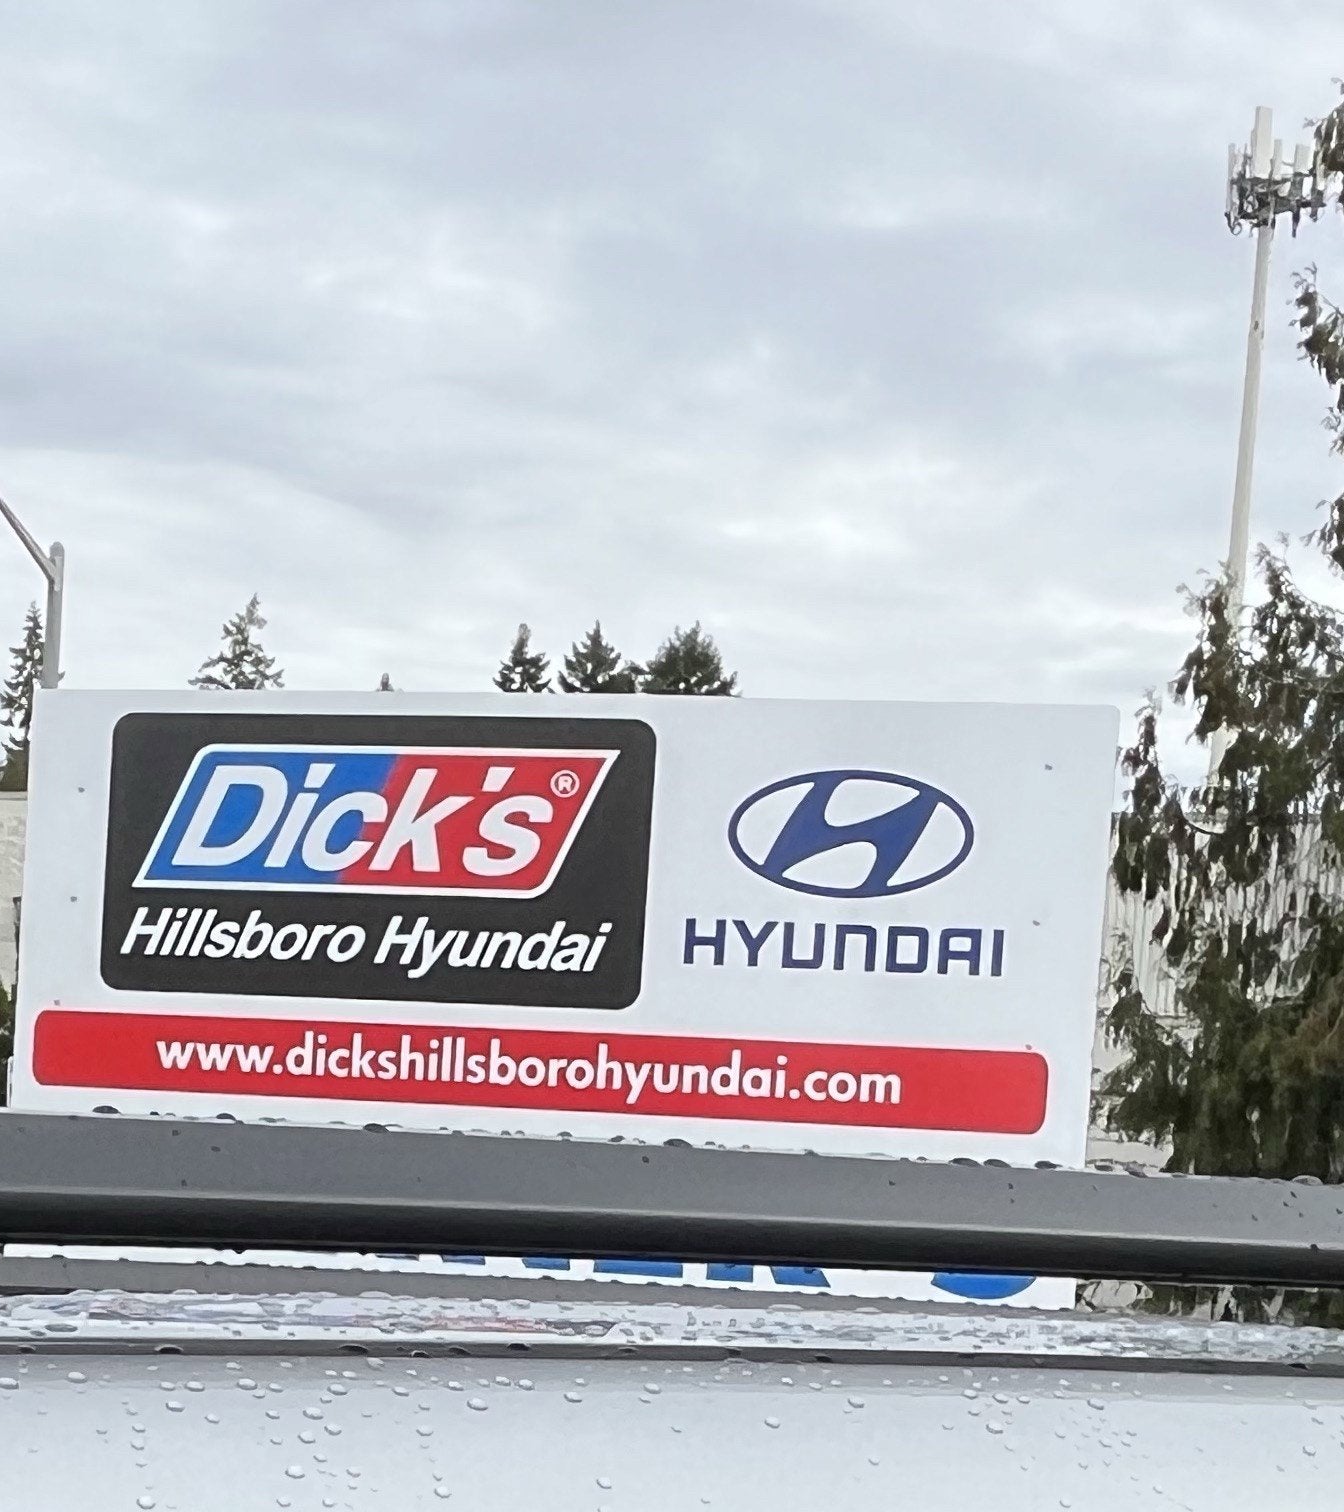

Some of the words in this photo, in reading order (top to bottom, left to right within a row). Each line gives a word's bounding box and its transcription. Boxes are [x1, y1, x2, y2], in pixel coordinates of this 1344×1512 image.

[171, 762, 554, 877] Dick's
[119, 906, 366, 964] Hillsboro
[373, 915, 613, 979] Hyundai
[683, 917, 1004, 978] HYUNDAI
[156, 1030, 901, 1107] www.dickshillsborohyundai.com
